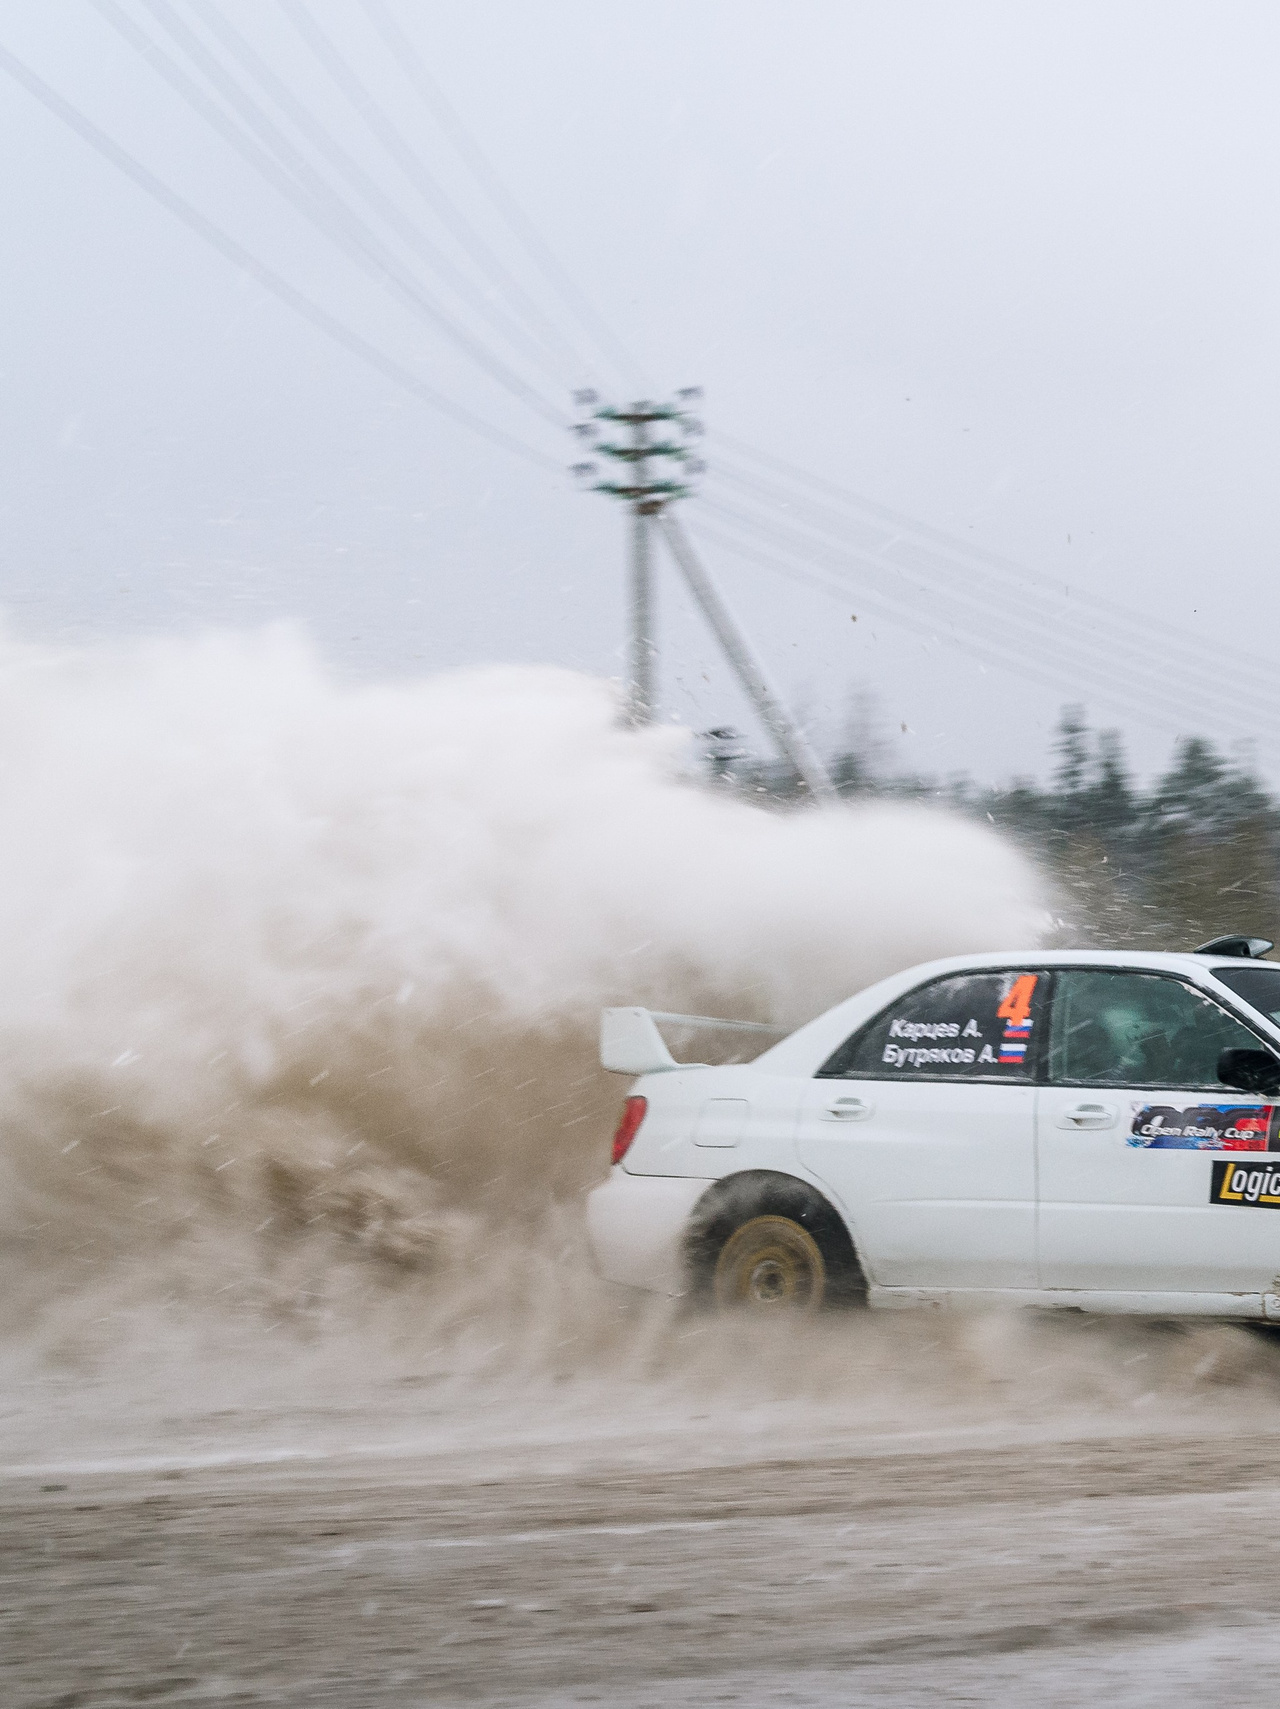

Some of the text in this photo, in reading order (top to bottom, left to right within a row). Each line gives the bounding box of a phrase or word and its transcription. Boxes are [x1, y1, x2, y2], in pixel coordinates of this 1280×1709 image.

[997, 974, 1038, 1026] 4
[888, 1018, 983, 1042] Карцев А.
[881, 1043, 998, 1068] Бутряков А.
[1140, 1124, 1255, 1140] Open Rally Cup
